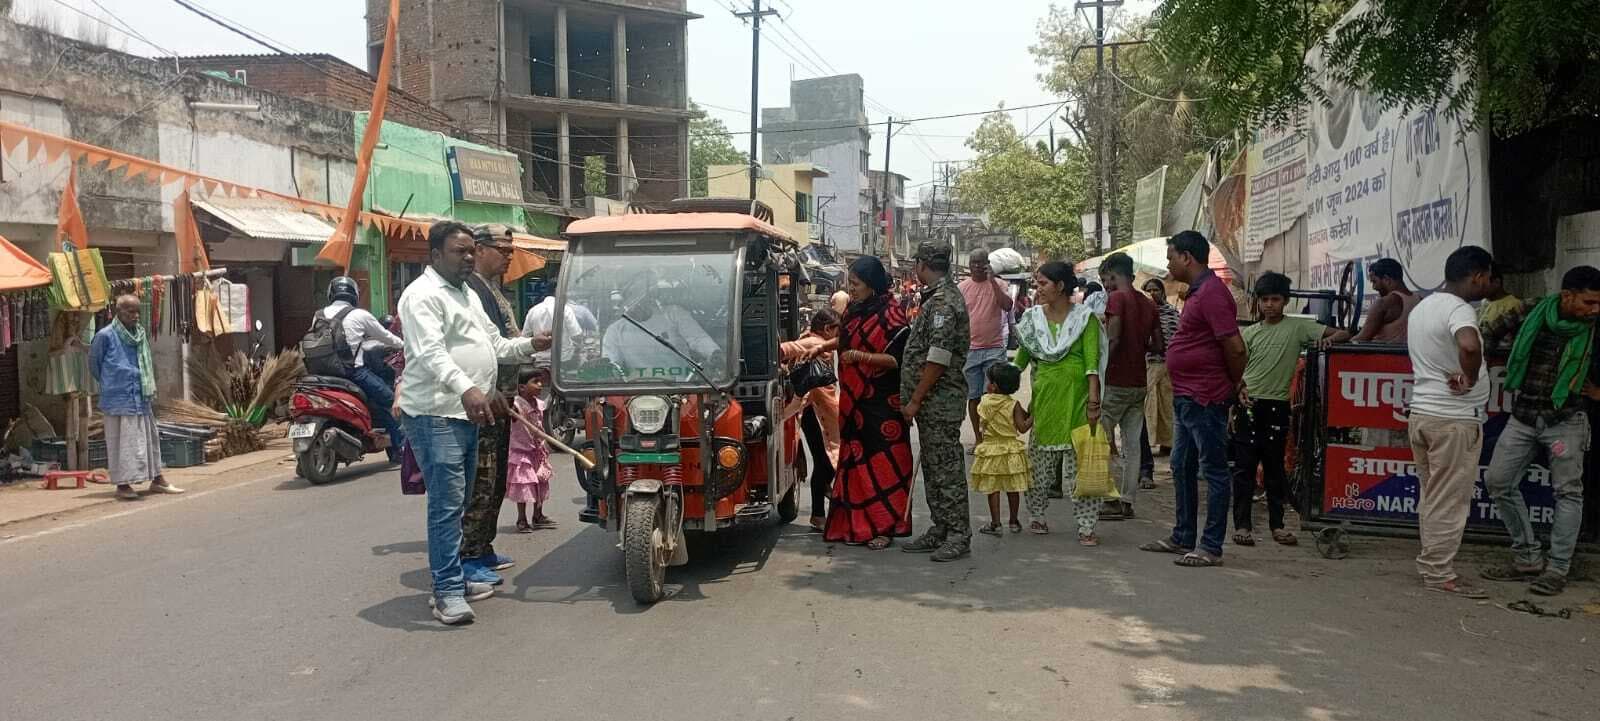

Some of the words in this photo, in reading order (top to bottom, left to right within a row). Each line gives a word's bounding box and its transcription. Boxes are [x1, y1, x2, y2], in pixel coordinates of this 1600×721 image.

[1322, 160, 1341, 183] आयु
[1343, 146, 1362, 170] 100
[463, 177, 500, 197] MEDICAL
[500, 182, 521, 199] HALL
[1315, 196, 1323, 213] 01
[1326, 191, 1342, 216] जून
[1344, 178, 1369, 203] 2024
[1371, 168, 1386, 192] को
